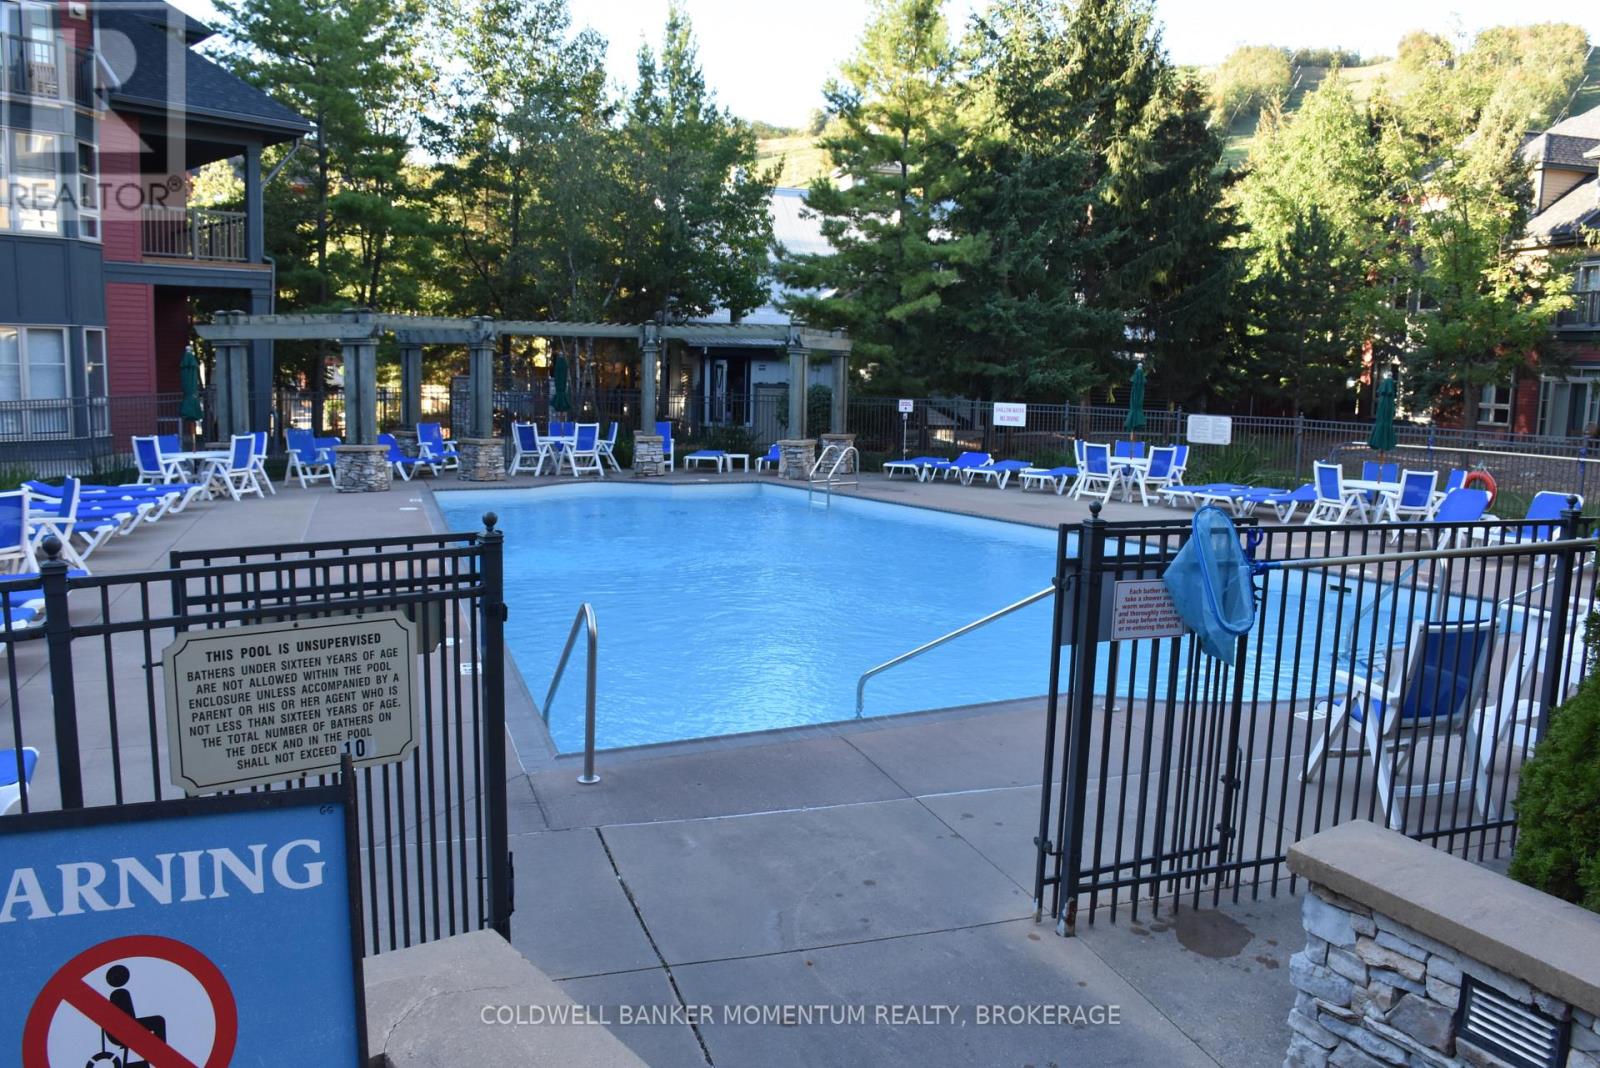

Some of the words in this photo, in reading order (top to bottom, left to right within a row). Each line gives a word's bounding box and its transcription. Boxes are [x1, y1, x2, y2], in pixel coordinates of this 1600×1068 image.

[187, 667, 235, 682] BATHERS
[241, 662, 276, 676] UNDER
[281, 657, 321, 670] SIXTEEN
[327, 652, 358, 664] YEARS
[363, 650, 375, 661] OF
[380, 648, 398, 658] AGE
[206, 649, 234, 662] THIS
[241, 645, 272, 658] POOL
[279, 643, 290, 654] IS
[296, 633, 381, 652] UNSUPERVISED
[188, 692, 251, 709] ENCLOSURE
[256, 686, 296, 700] UNLESS
[302, 677, 370, 694] ACCOMPANIED
[376, 674, 388, 684] BY
[393, 673, 400, 682] A
[196, 683, 216, 694] ARE
[223, 680, 243, 690] NOT
[250, 672, 298, 688] ALLOWED
[303, 668, 338, 680] WITHIN
[344, 664, 362, 676] THE
[367, 662, 392, 672] POOL
[190, 724, 210, 736] NOT
[216, 720, 242, 732] LESS
[248, 716, 274, 728] THAN
[281, 709, 320, 724] SIXTEEN
[326, 704, 358, 716] YEARS
[362, 702, 374, 712] OF
[380, 698, 400, 710] AGE.
[192, 708, 232, 722] PARENT
[238, 705, 252, 716] OR
[258, 702, 276, 713] HIS
[282, 700, 295, 710] OR
[300, 696, 320, 708] HER
[326, 691, 356, 704] AGENT
[362, 688, 384, 699] WHO
[389, 686, 398, 696] IS
[202, 736, 222, 748] THE
[228, 732, 259, 744] TOTAL
[266, 724, 308, 738] NUMBER
[313, 721, 326, 732] OF
[330, 714, 374, 730] BATHERS
[378, 712, 392, 722] ON
[226, 746, 245, 758] THE
[251, 742, 278, 754] DECK
[283, 738, 303, 750] AND
[309, 736, 318, 746] IN
[324, 732, 342, 742] THE
[348, 728, 372, 740] POOL
[237, 756, 270, 770] SHALL
[275, 752, 295, 764] NOT
[300, 746, 336, 760] EXCEED
[344, 739, 365, 757] 10
[0, 839, 326, 923] ARNING
